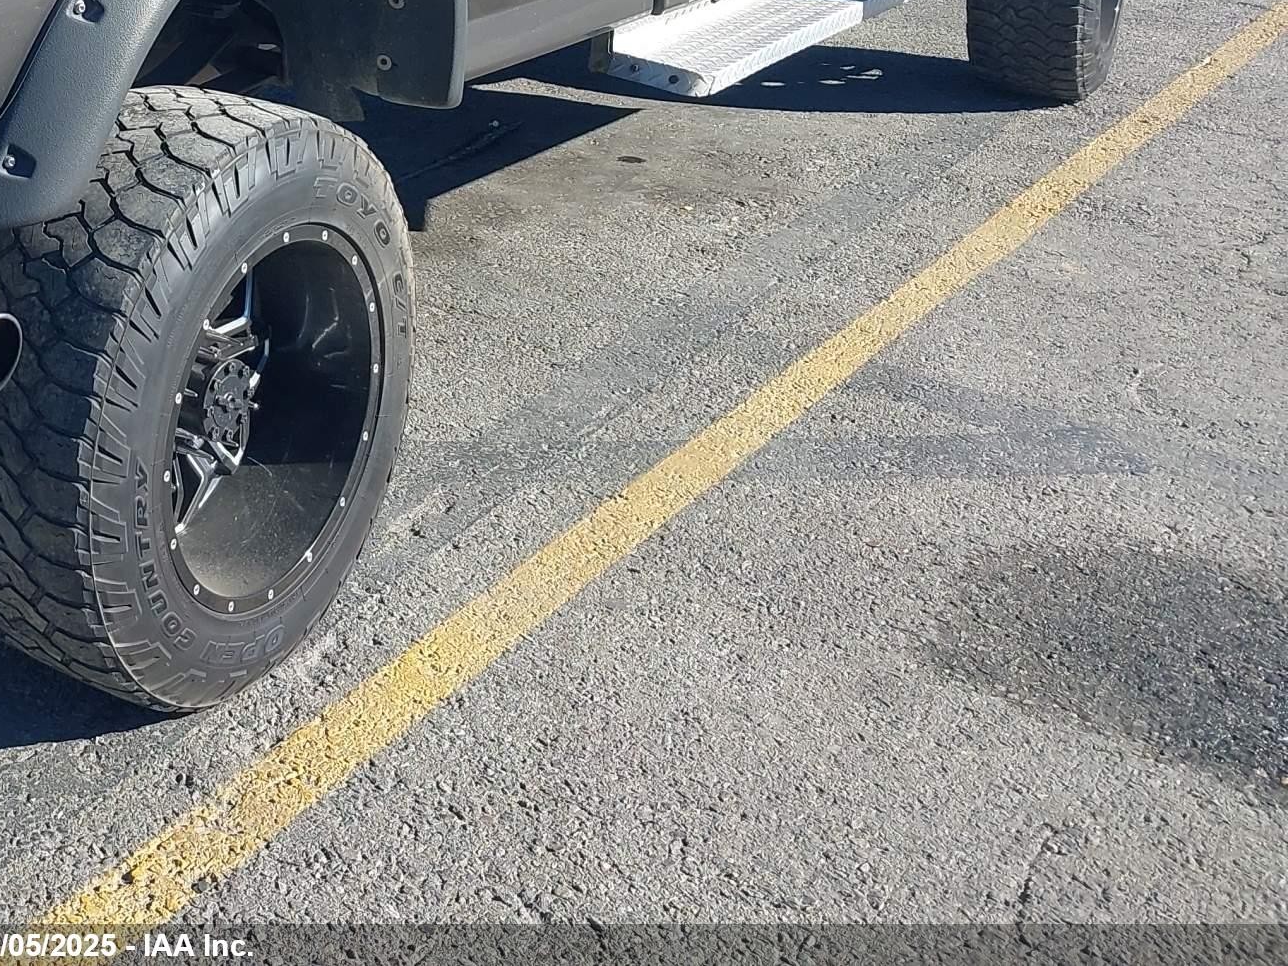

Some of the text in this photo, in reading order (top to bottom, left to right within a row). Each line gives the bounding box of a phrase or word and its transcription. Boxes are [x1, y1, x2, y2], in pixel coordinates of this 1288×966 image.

[313, 177, 392, 249] TOYO
[134, 456, 198, 651] COUNTRY
[199, 624, 286, 664] OPEN
